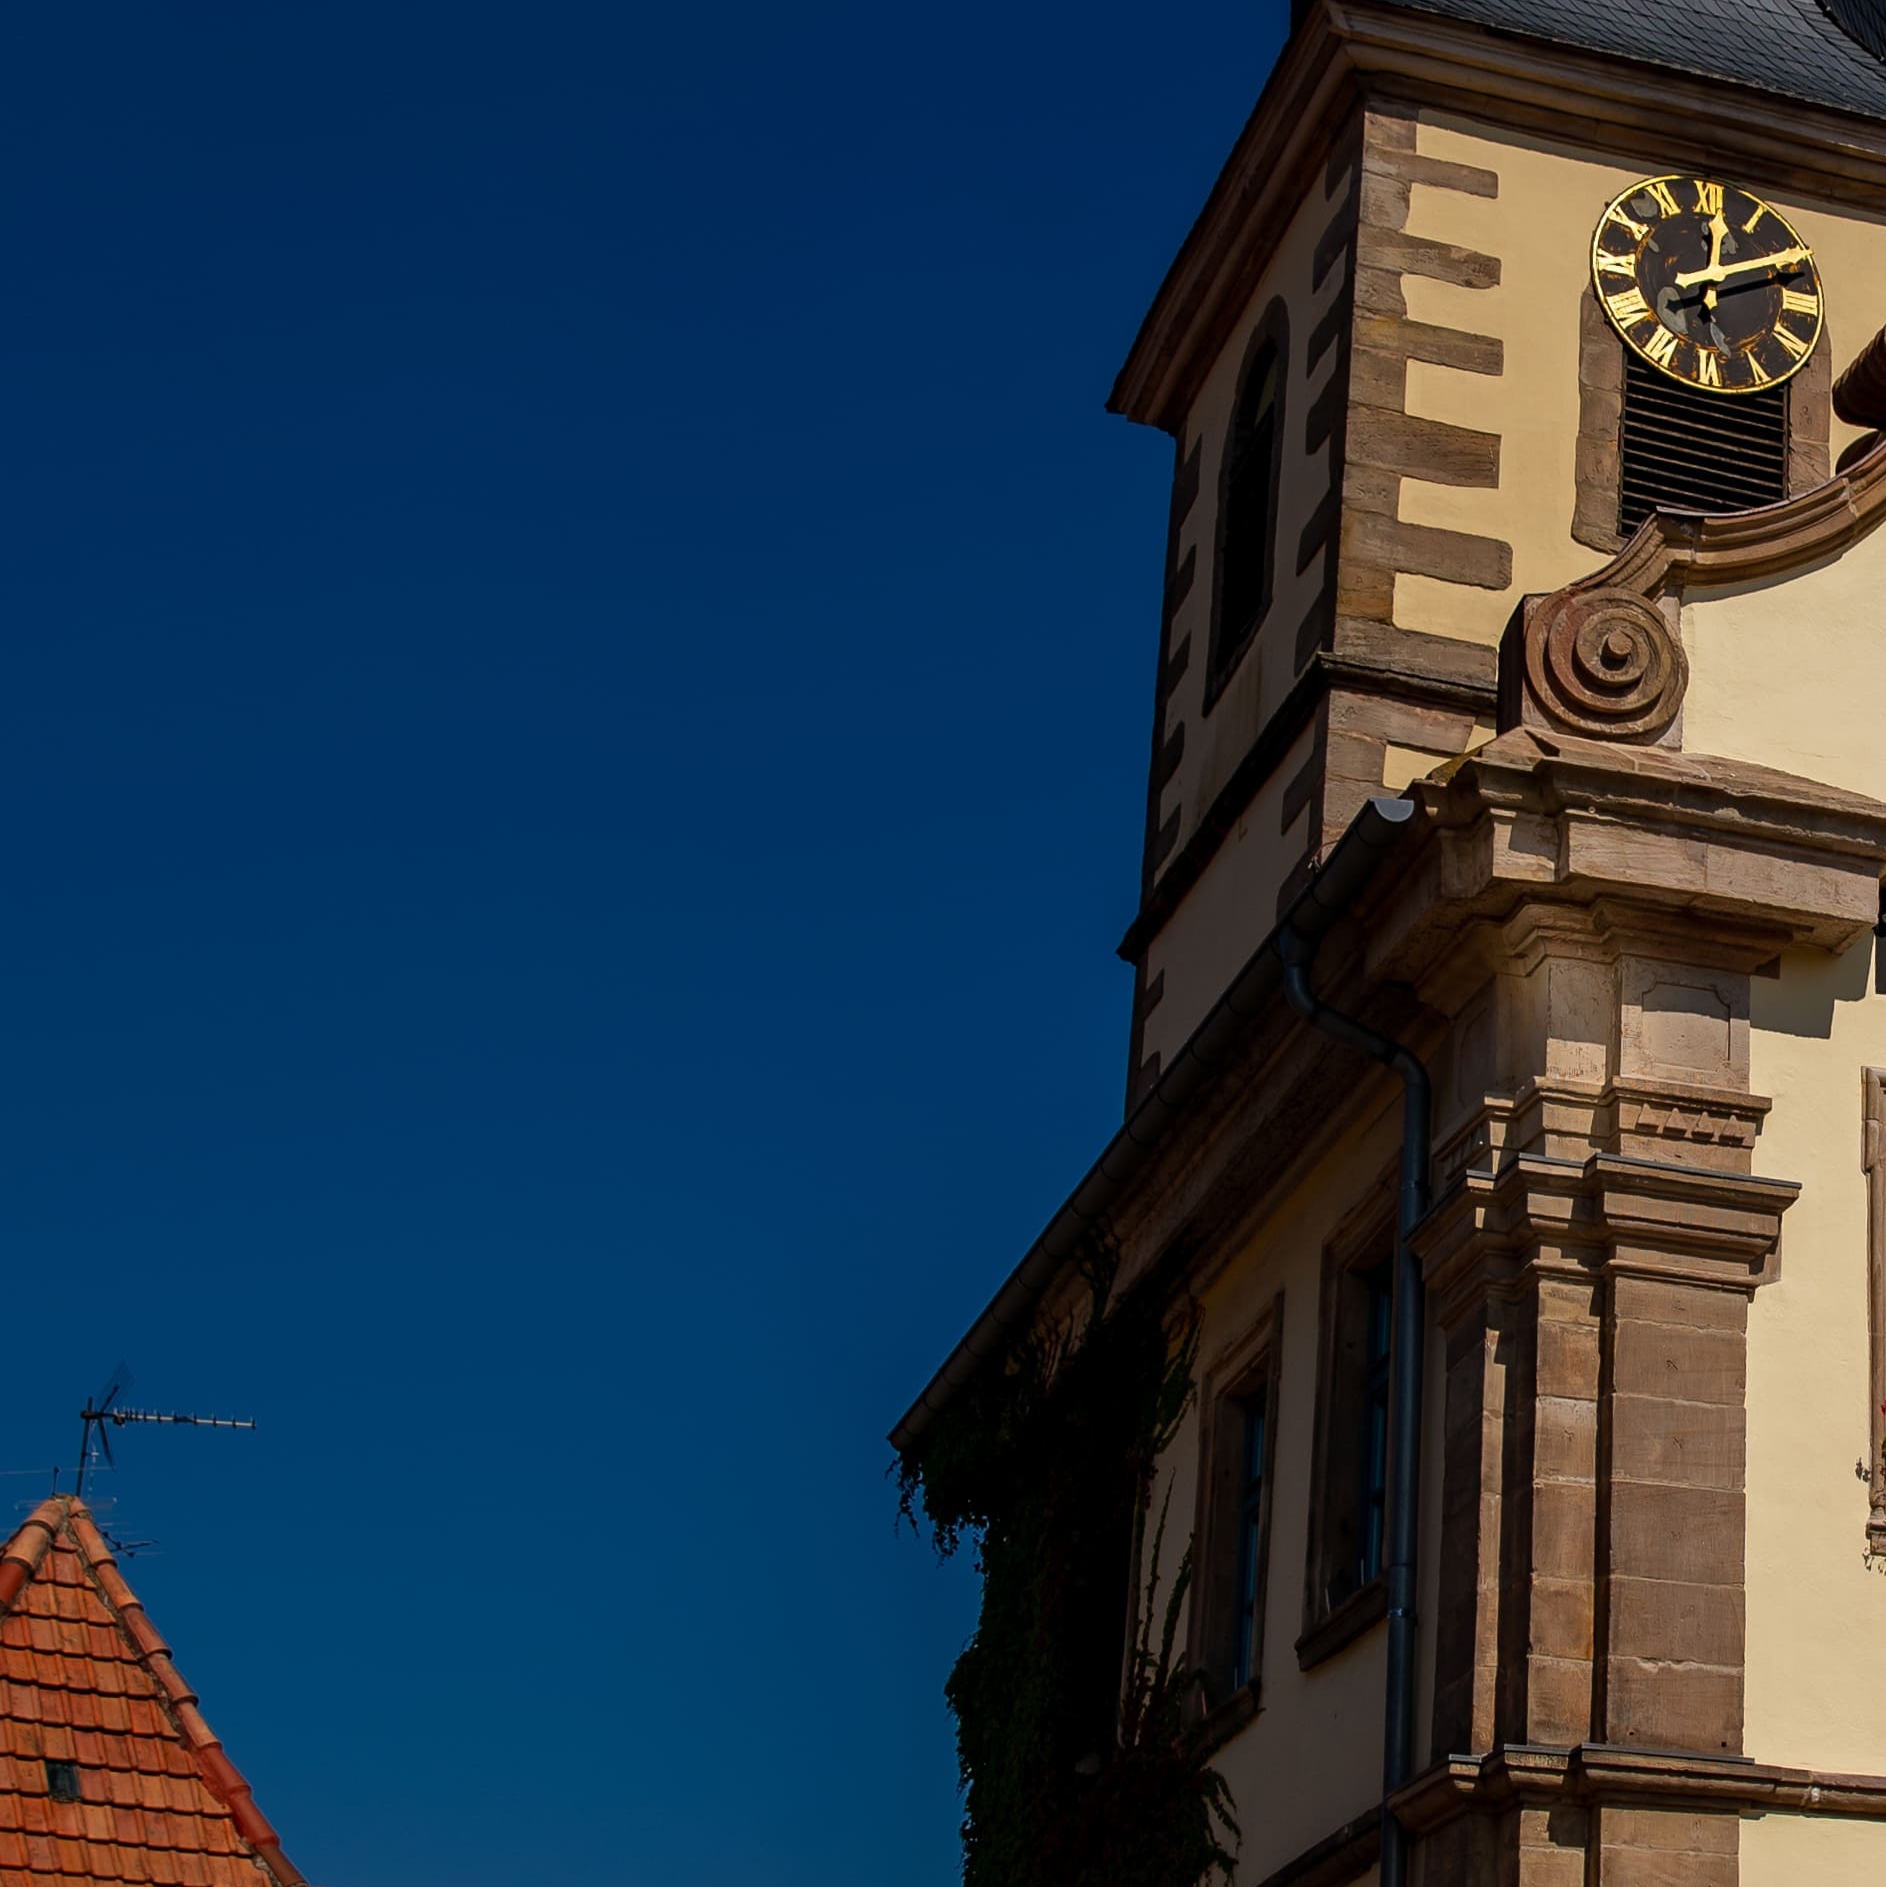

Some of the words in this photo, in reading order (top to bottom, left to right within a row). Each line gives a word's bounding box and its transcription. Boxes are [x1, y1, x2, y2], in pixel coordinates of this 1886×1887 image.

[1645, 181, 1681, 218] XI
[1693, 180, 1726, 215] XII
[1607, 205, 1650, 241] X
[1742, 204, 1767, 234] I
[1596, 248, 1636, 278] IX
[1606, 287, 1651, 330] VIII
[1782, 288, 1818, 316] III
[1643, 325, 1679, 368] VII
[1772, 323, 1810, 361] IV
[1697, 348, 1722, 387] VI
[1745, 349, 1771, 386] V
